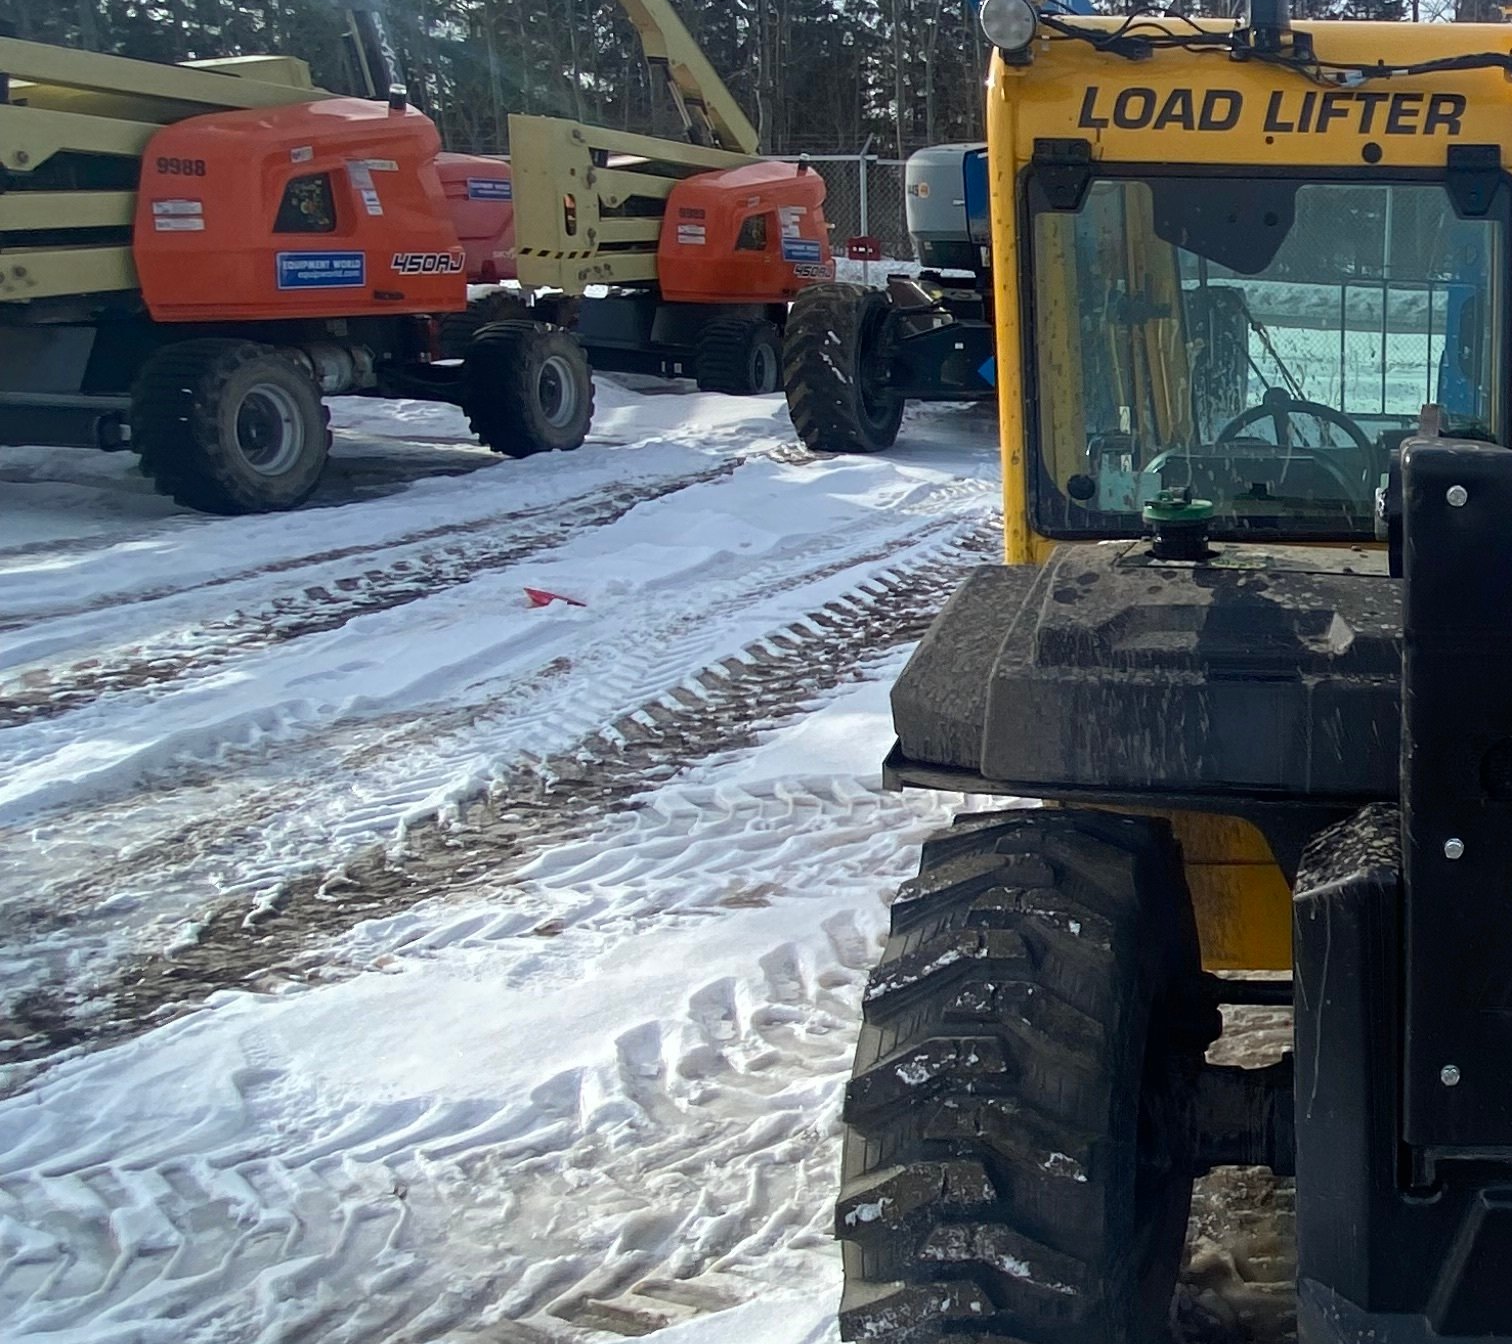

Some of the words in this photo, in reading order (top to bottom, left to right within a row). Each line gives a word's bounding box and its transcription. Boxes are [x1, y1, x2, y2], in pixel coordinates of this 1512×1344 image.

[1077, 86, 1243, 131] LOAD
[1263, 90, 1467, 136] LIFTER
[156, 157, 206, 176] 9988
[391, 253, 465, 275] 450AJ
